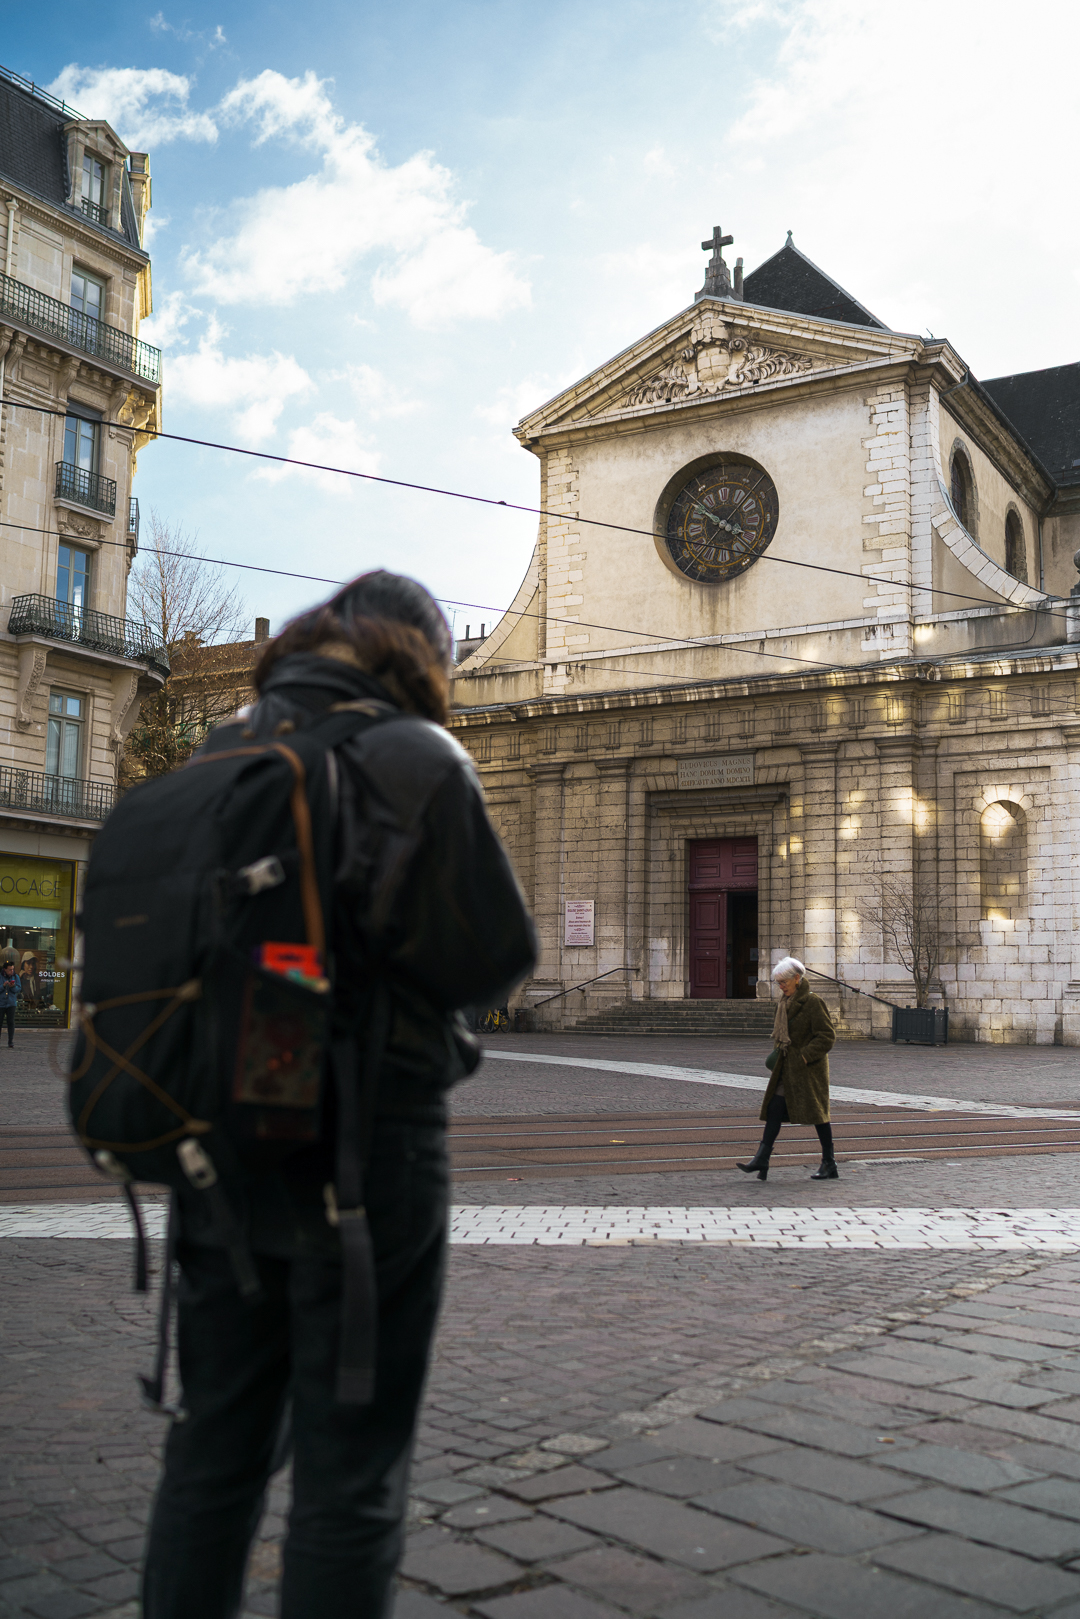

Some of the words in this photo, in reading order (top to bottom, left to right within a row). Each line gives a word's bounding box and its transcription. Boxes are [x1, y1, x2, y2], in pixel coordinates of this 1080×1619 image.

[680, 761, 718, 769] LUDOVICUS
[722, 758, 751, 766] MAGNUS
[680, 771, 697, 779] HANC
[726, 767, 751, 775] DOMINO
[0, 875, 61, 898] OCAGE
[38, 970, 66, 978] SOLDES
